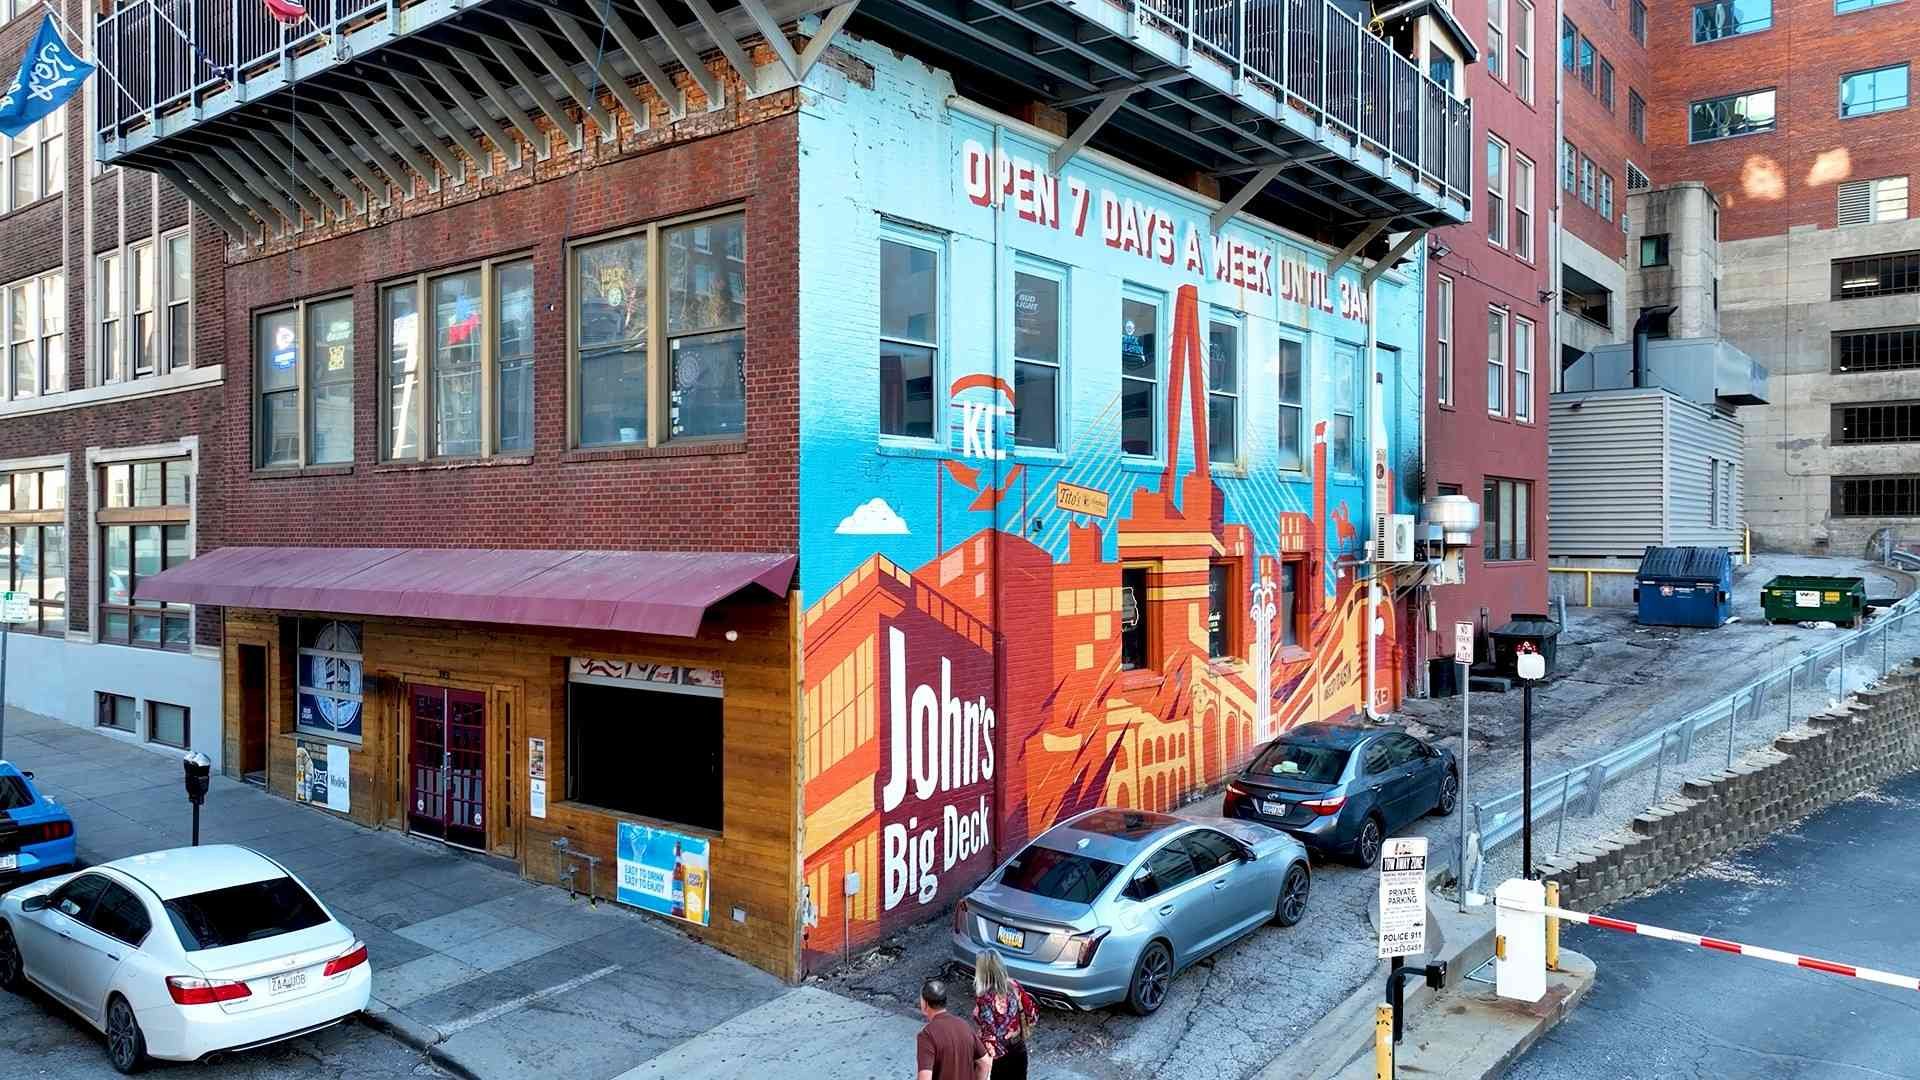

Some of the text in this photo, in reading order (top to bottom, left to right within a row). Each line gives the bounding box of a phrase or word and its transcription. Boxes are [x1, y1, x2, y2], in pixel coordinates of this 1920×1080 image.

[963, 139, 1059, 229] OPEN
[1067, 176, 1090, 236] 7
[1101, 189, 1175, 265] DAYS
[1183, 221, 1204, 276] A
[1210, 234, 1272, 296] WEEK
[1277, 252, 1333, 314] UNTIL
[963, 400, 1006, 460] KC
[883, 626, 995, 813] John's
[884, 796, 990, 912] Big Deck
[624, 864, 638, 879] EASY
[624, 874, 638, 889] EASY
[1389, 887, 1416, 896] PRIVATE
[1388, 895, 1417, 904] PARKING
[1384, 931, 1422, 943] POLICE 911
